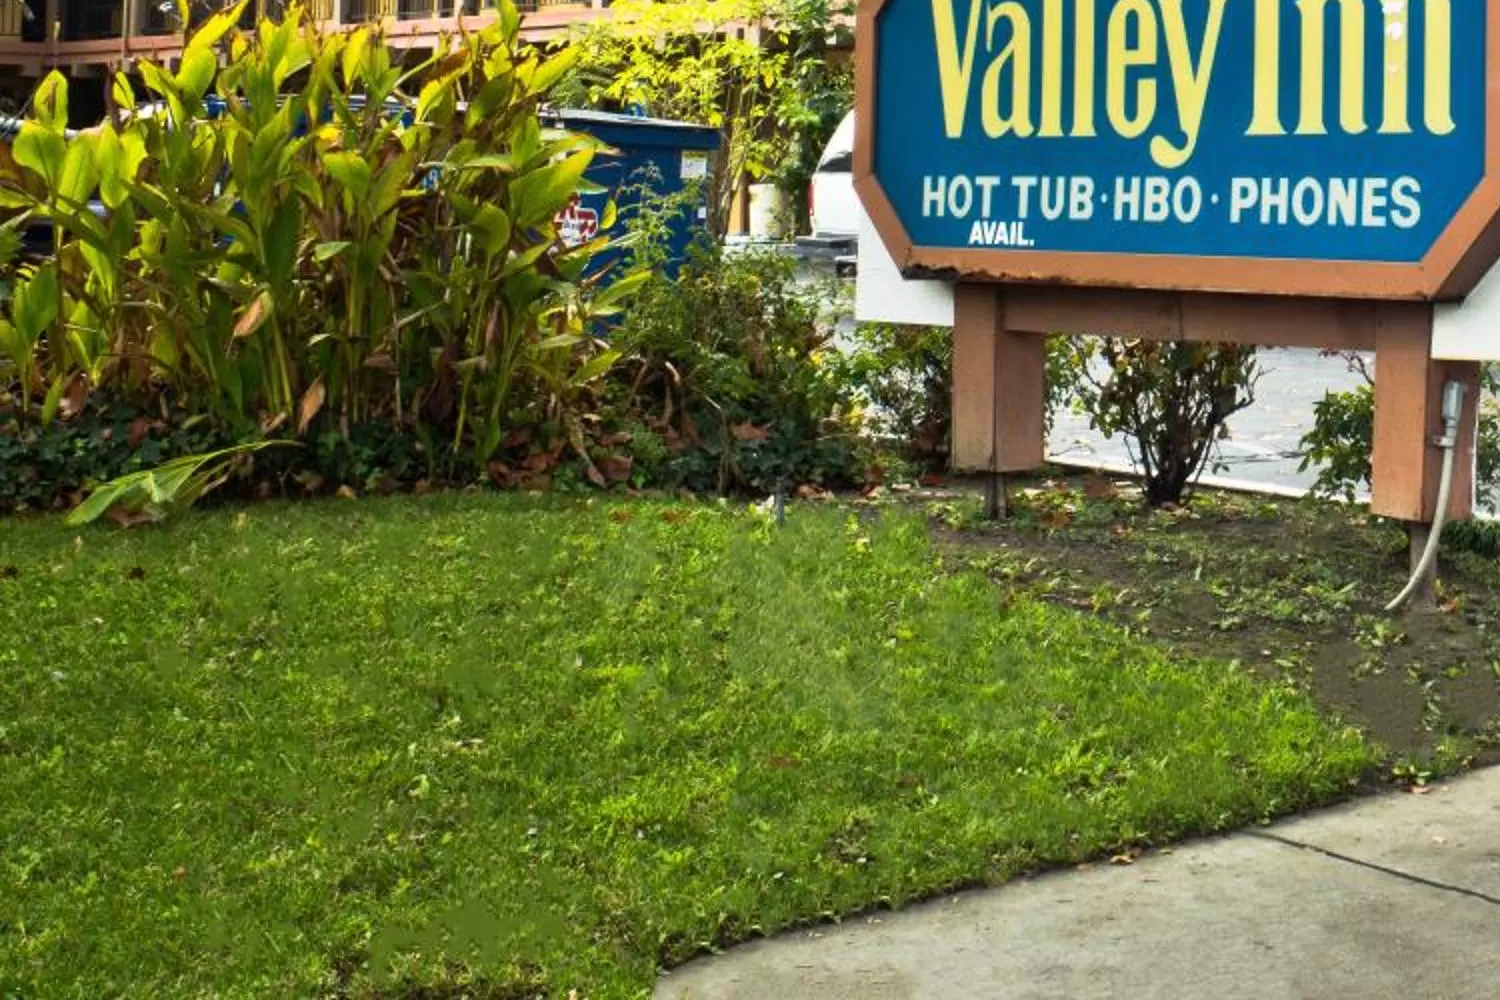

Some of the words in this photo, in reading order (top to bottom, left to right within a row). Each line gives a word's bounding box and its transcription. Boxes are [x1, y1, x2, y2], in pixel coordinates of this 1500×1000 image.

[922, 175, 1000, 220] HOT
[1012, 175, 1094, 222] TUB
[1114, 176, 1202, 224] HBO
[1230, 176, 1421, 229] PHONES
[969, 220, 1034, 246] AVAIL.
